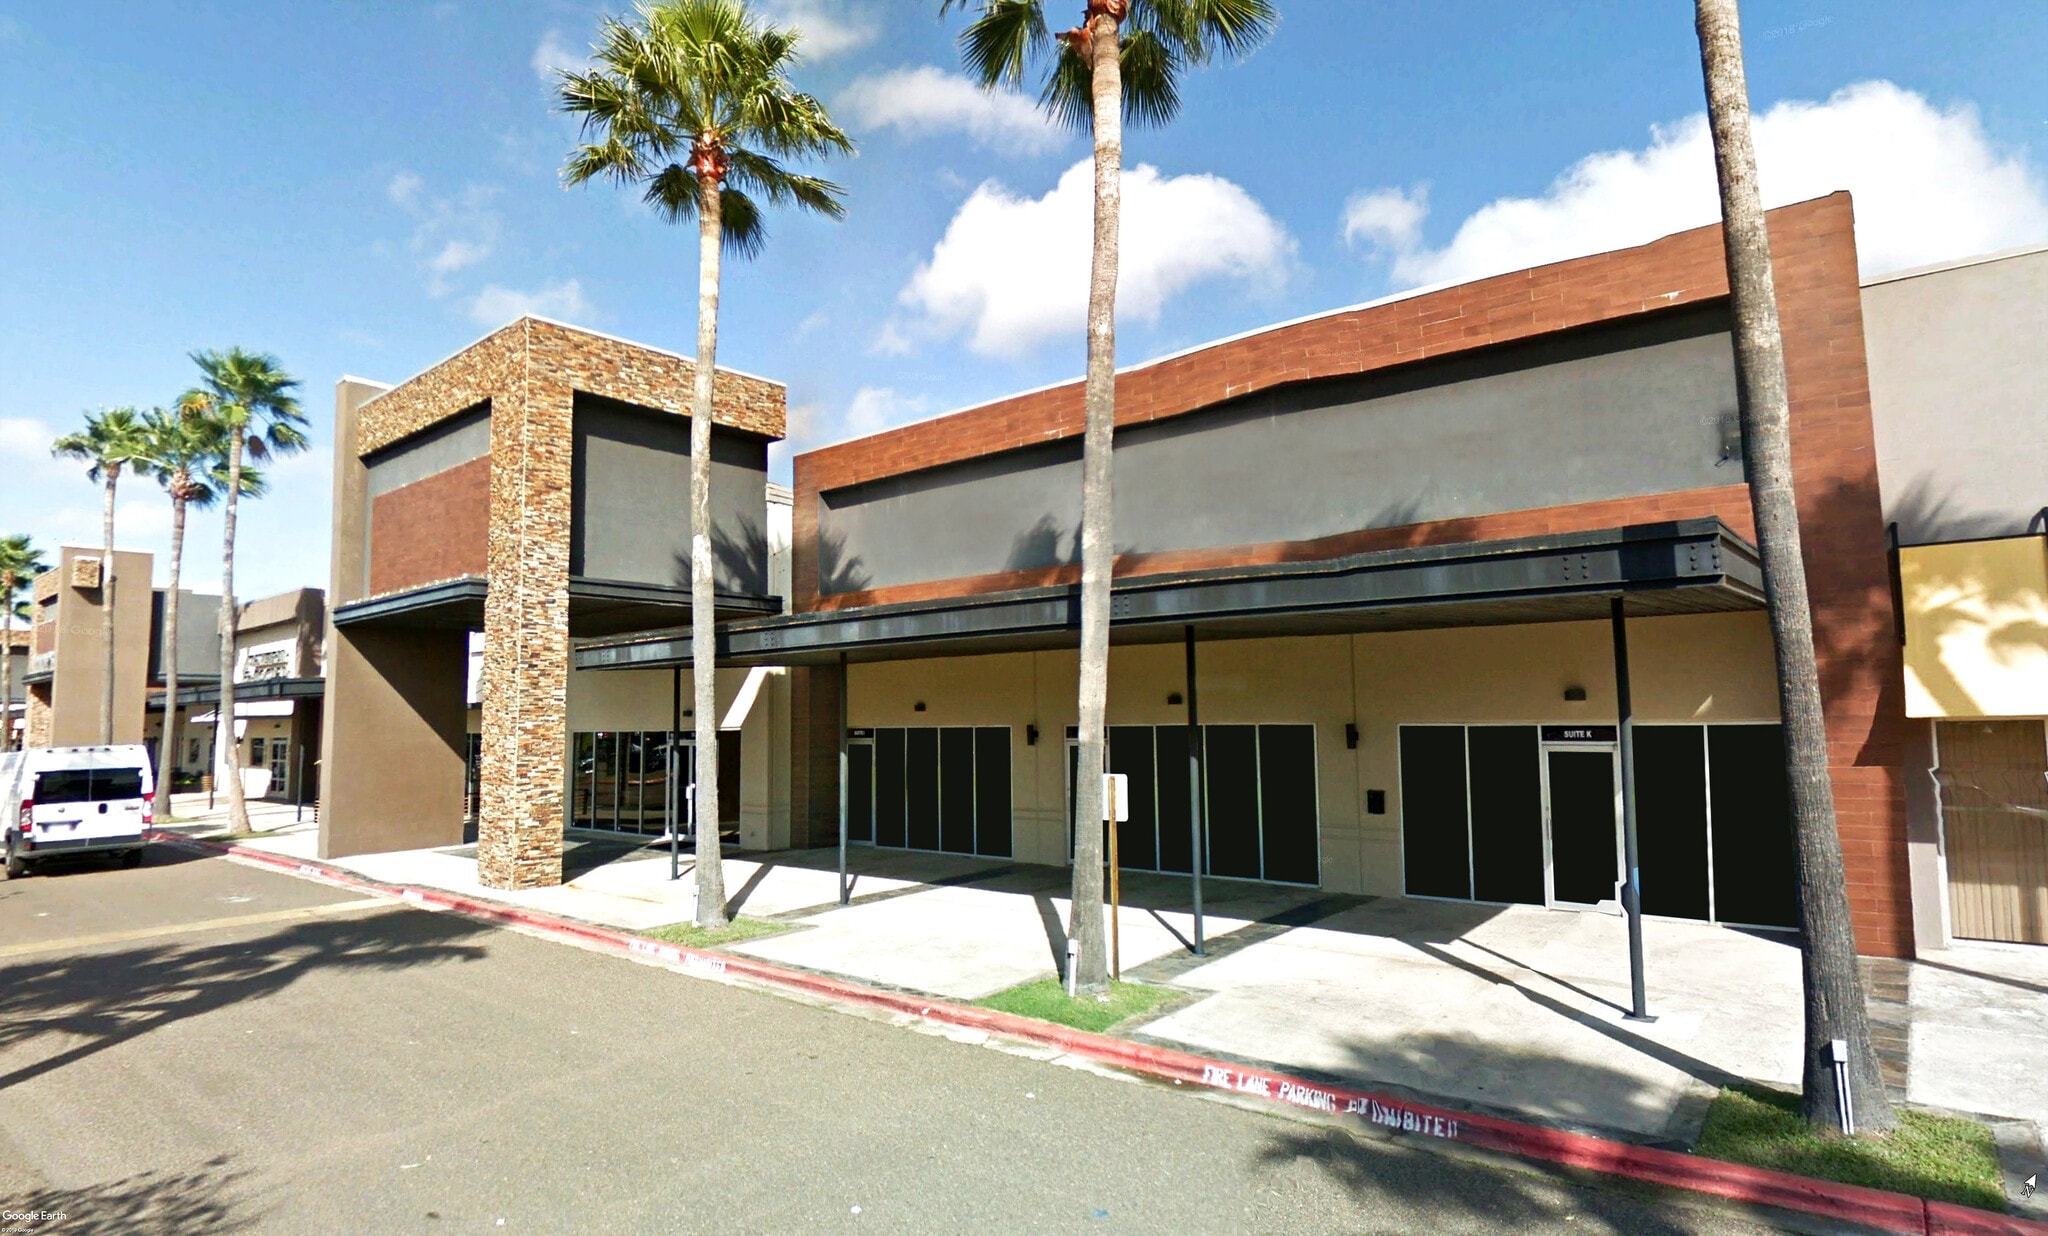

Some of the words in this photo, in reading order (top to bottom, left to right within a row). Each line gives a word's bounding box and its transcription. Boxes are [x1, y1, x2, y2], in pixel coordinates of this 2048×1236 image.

[1564, 730, 1585, 738] SUITE
[1586, 730, 1592, 738] K
[1202, 1065, 1232, 1089] FIRE
[1236, 1072, 1271, 1097] LANE
[1278, 1081, 1336, 1112] PARKING
